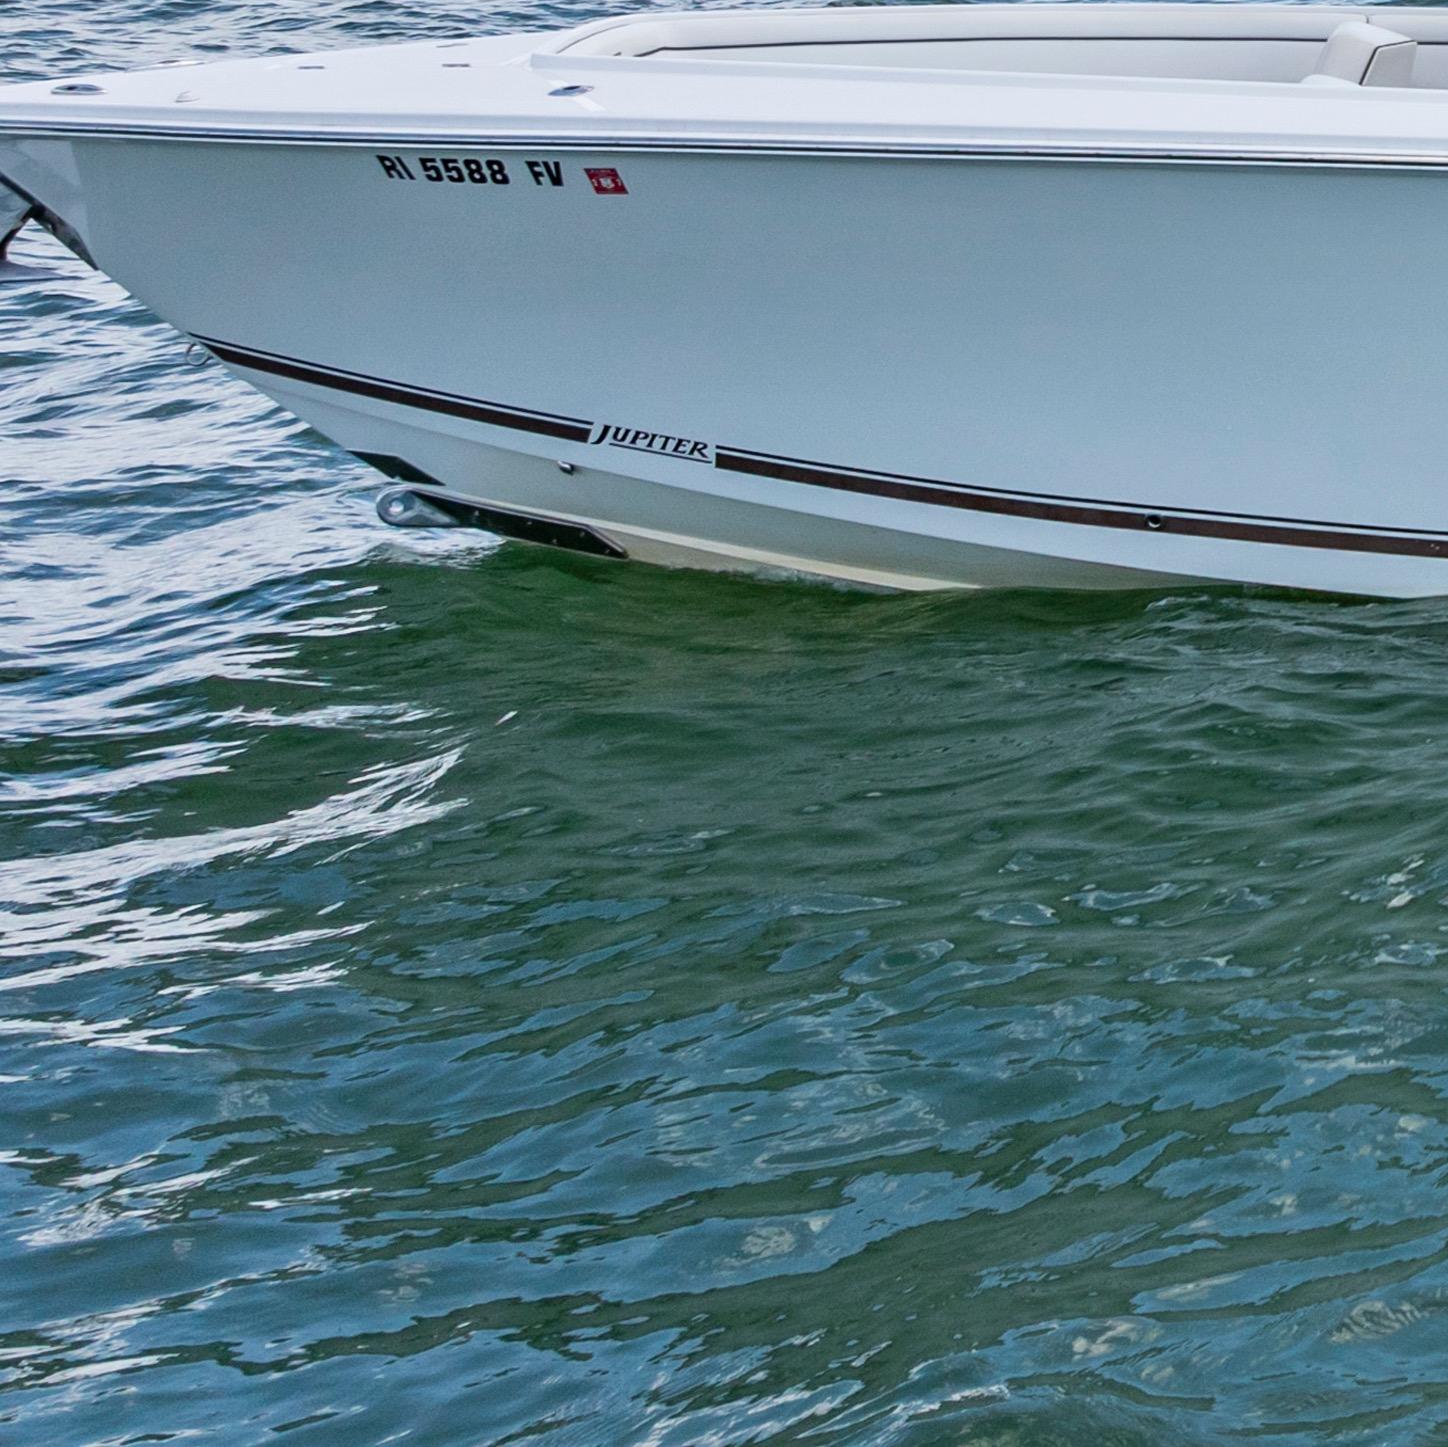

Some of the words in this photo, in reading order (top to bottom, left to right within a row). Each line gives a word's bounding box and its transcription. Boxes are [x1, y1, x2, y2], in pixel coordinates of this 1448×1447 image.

[376, 155, 416, 180] RI
[418, 157, 510, 184] 5588
[525, 160, 564, 186] FV
[590, 424, 710, 459] JUPITER
